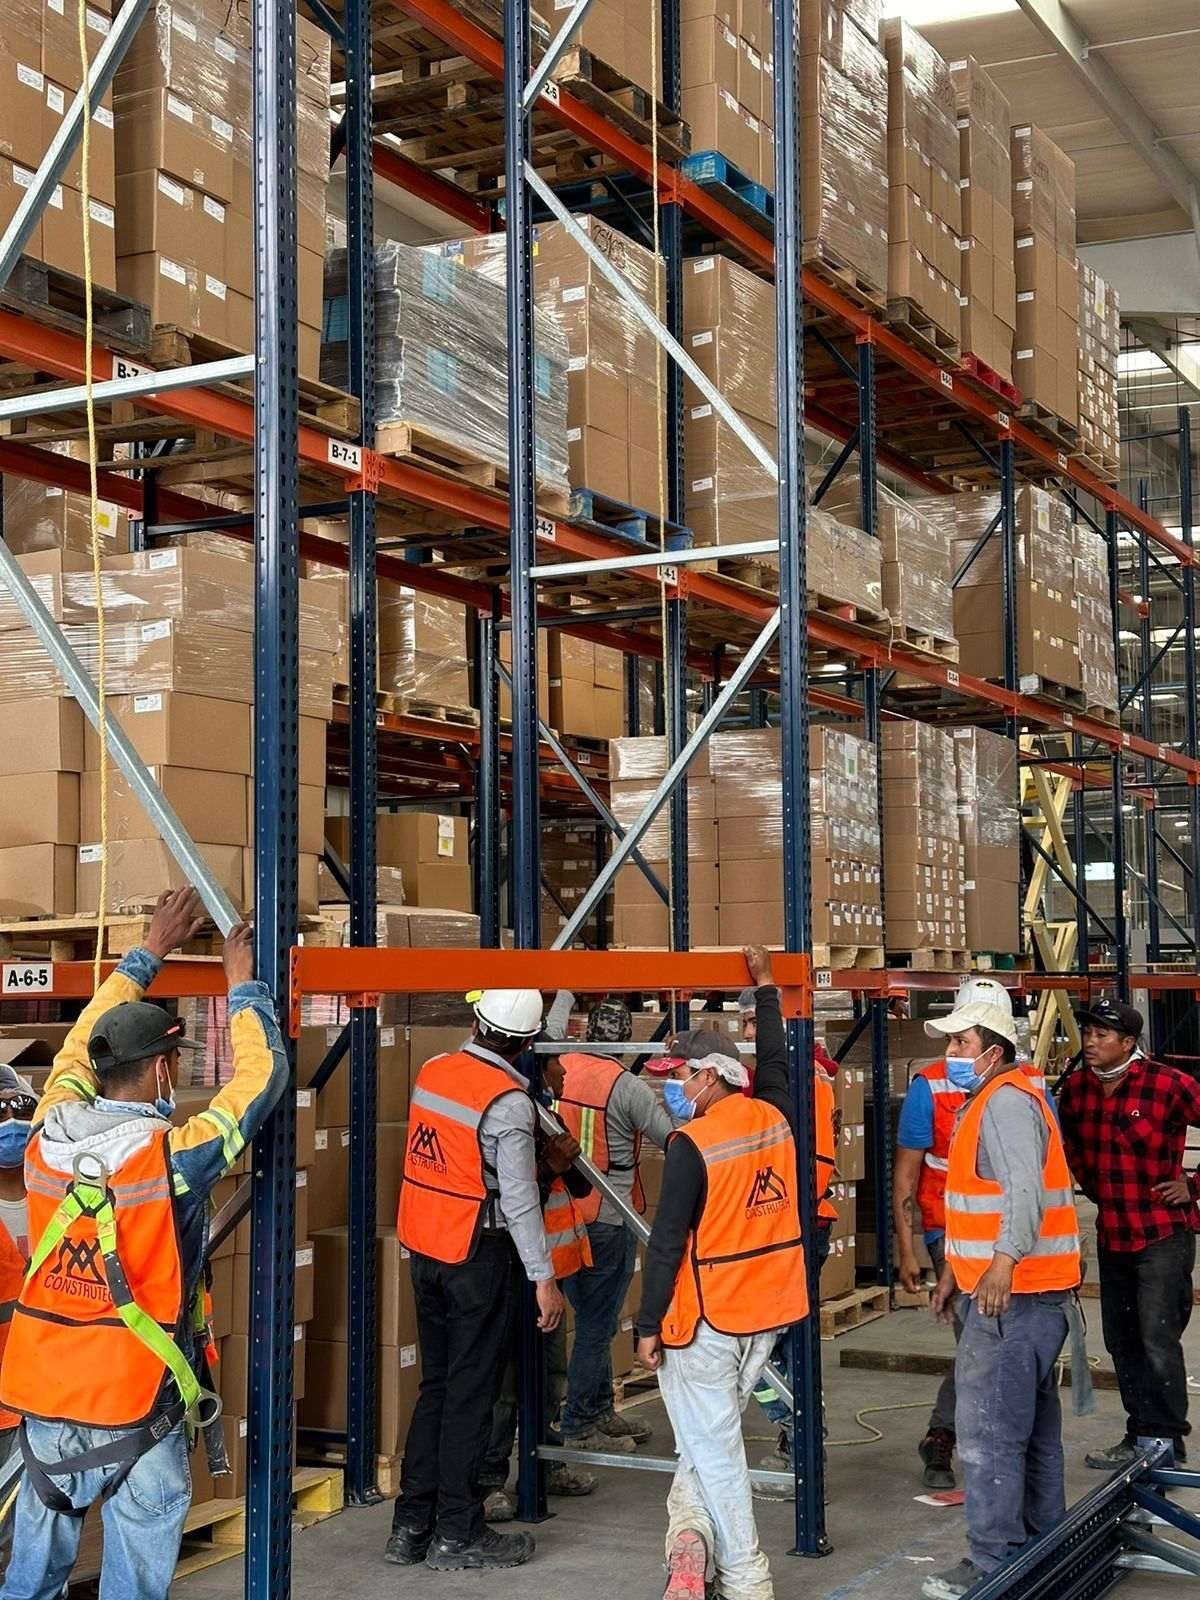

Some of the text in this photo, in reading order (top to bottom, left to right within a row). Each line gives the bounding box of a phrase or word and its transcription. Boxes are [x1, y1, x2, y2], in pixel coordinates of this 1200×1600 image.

[332, 444, 358, 465] B-7-1
[7, 969, 48, 987] A-6-5
[44, 1275, 113, 1302] CONSTRUTEC
